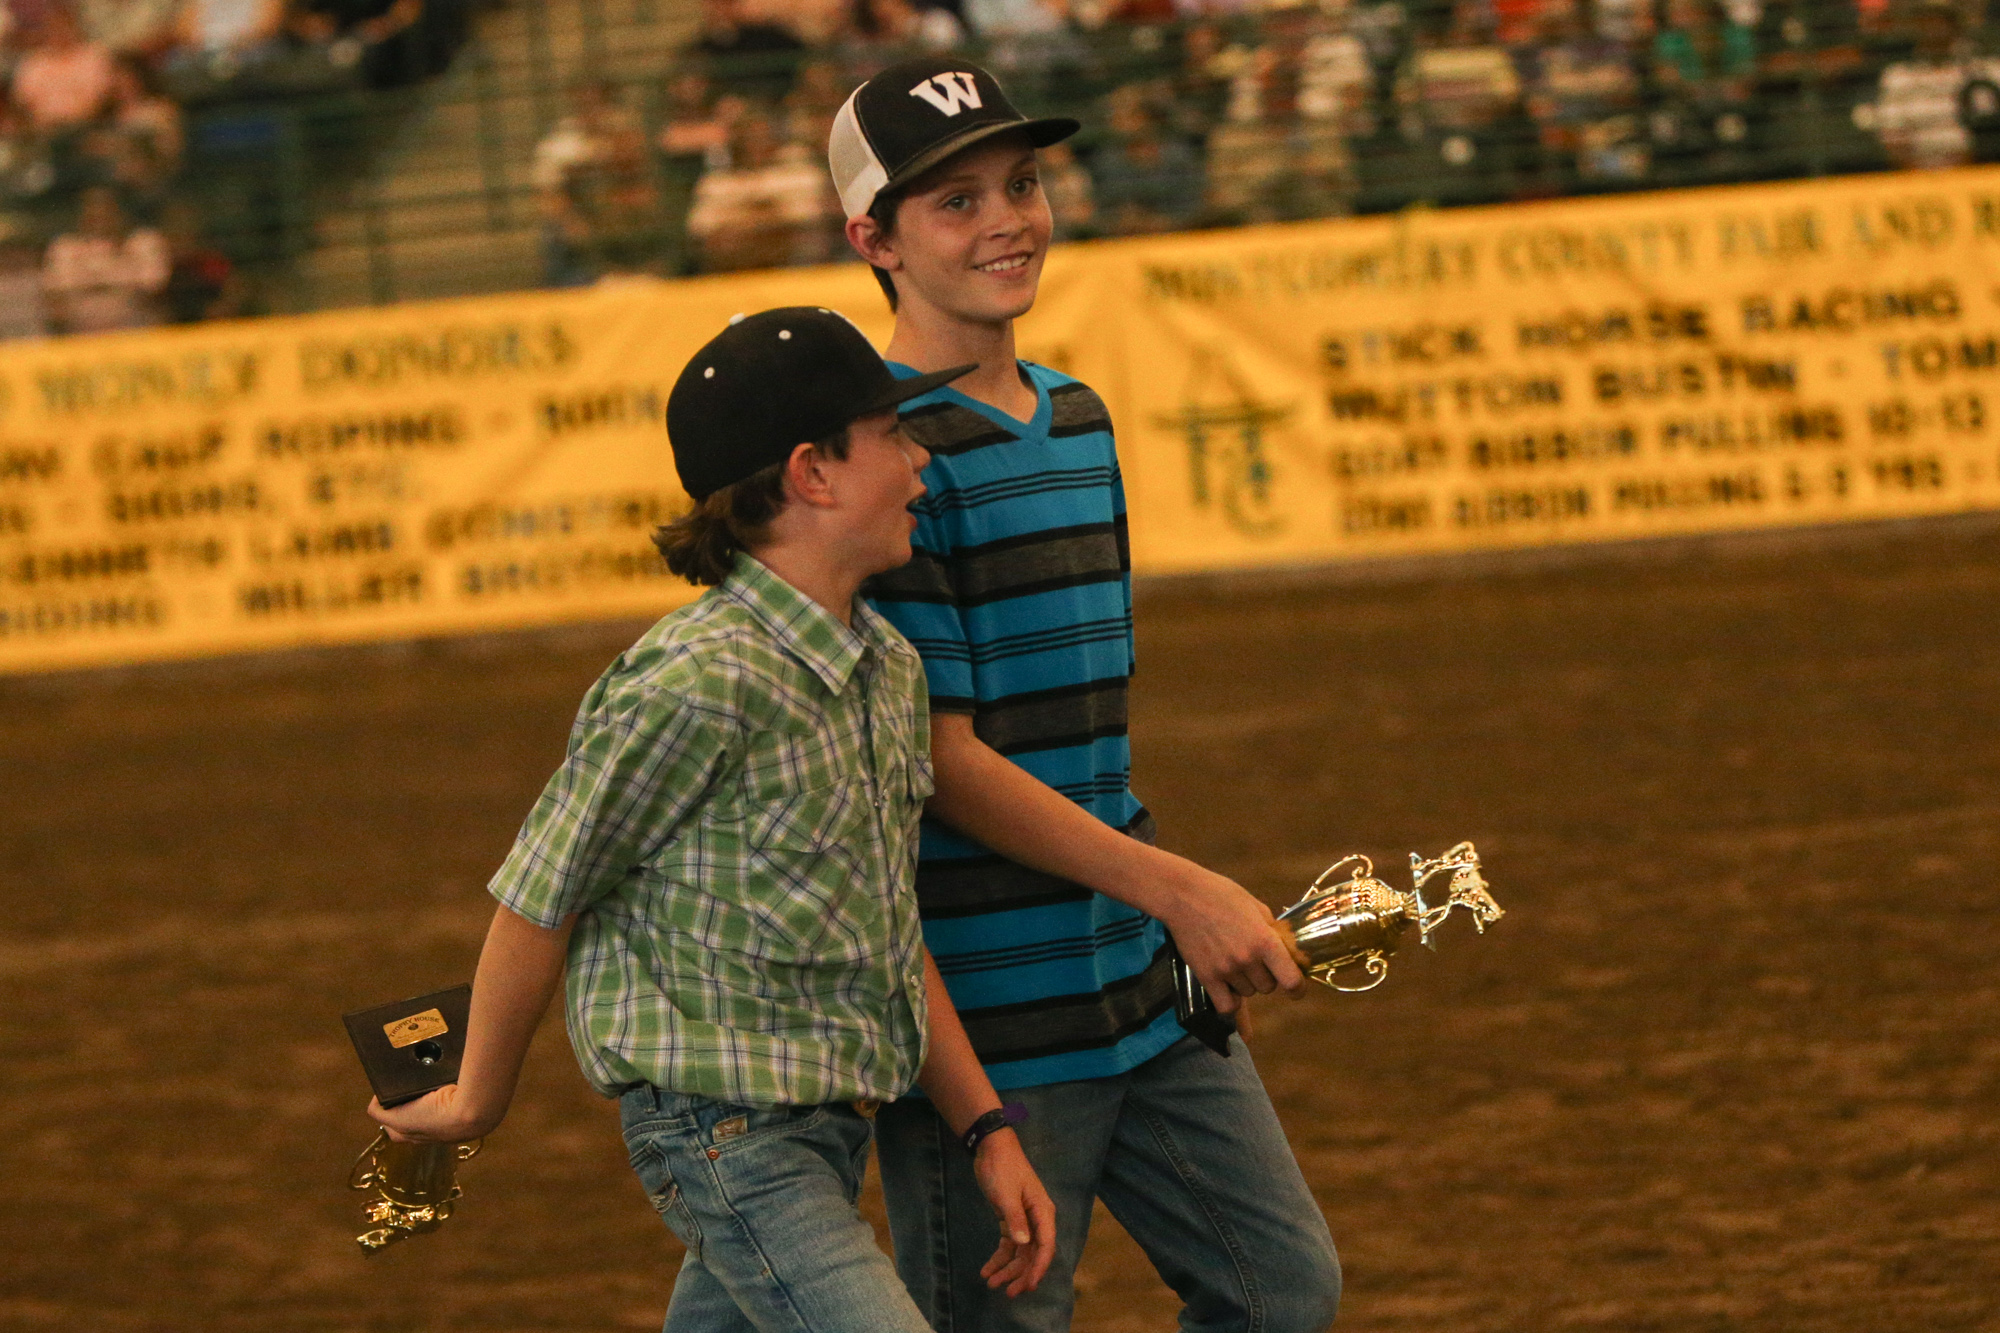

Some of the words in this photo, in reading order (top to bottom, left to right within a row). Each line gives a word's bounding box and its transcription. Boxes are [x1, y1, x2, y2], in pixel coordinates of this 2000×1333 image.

[909, 71, 983, 117] W
[1740, 280, 1963, 338] RACING
[389, 1018, 413, 1037] TROPHY
